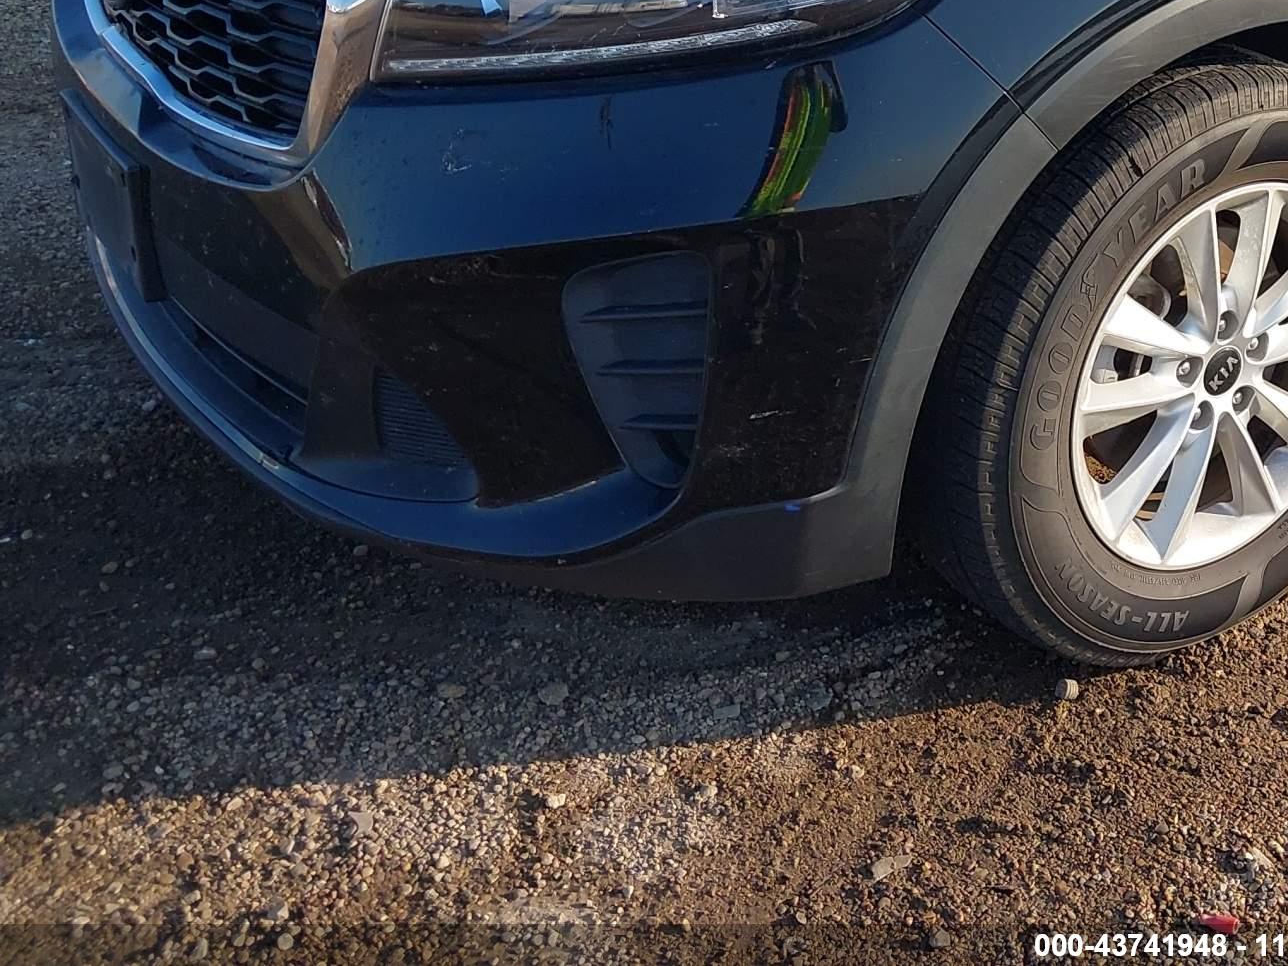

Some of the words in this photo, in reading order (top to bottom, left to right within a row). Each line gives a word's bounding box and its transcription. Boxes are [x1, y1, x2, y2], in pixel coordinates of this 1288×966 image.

[1030, 159, 1207, 451] GOODYEAR
[1208, 356, 1239, 392] KIA
[1054, 557, 1190, 633] ALL-SEASON
